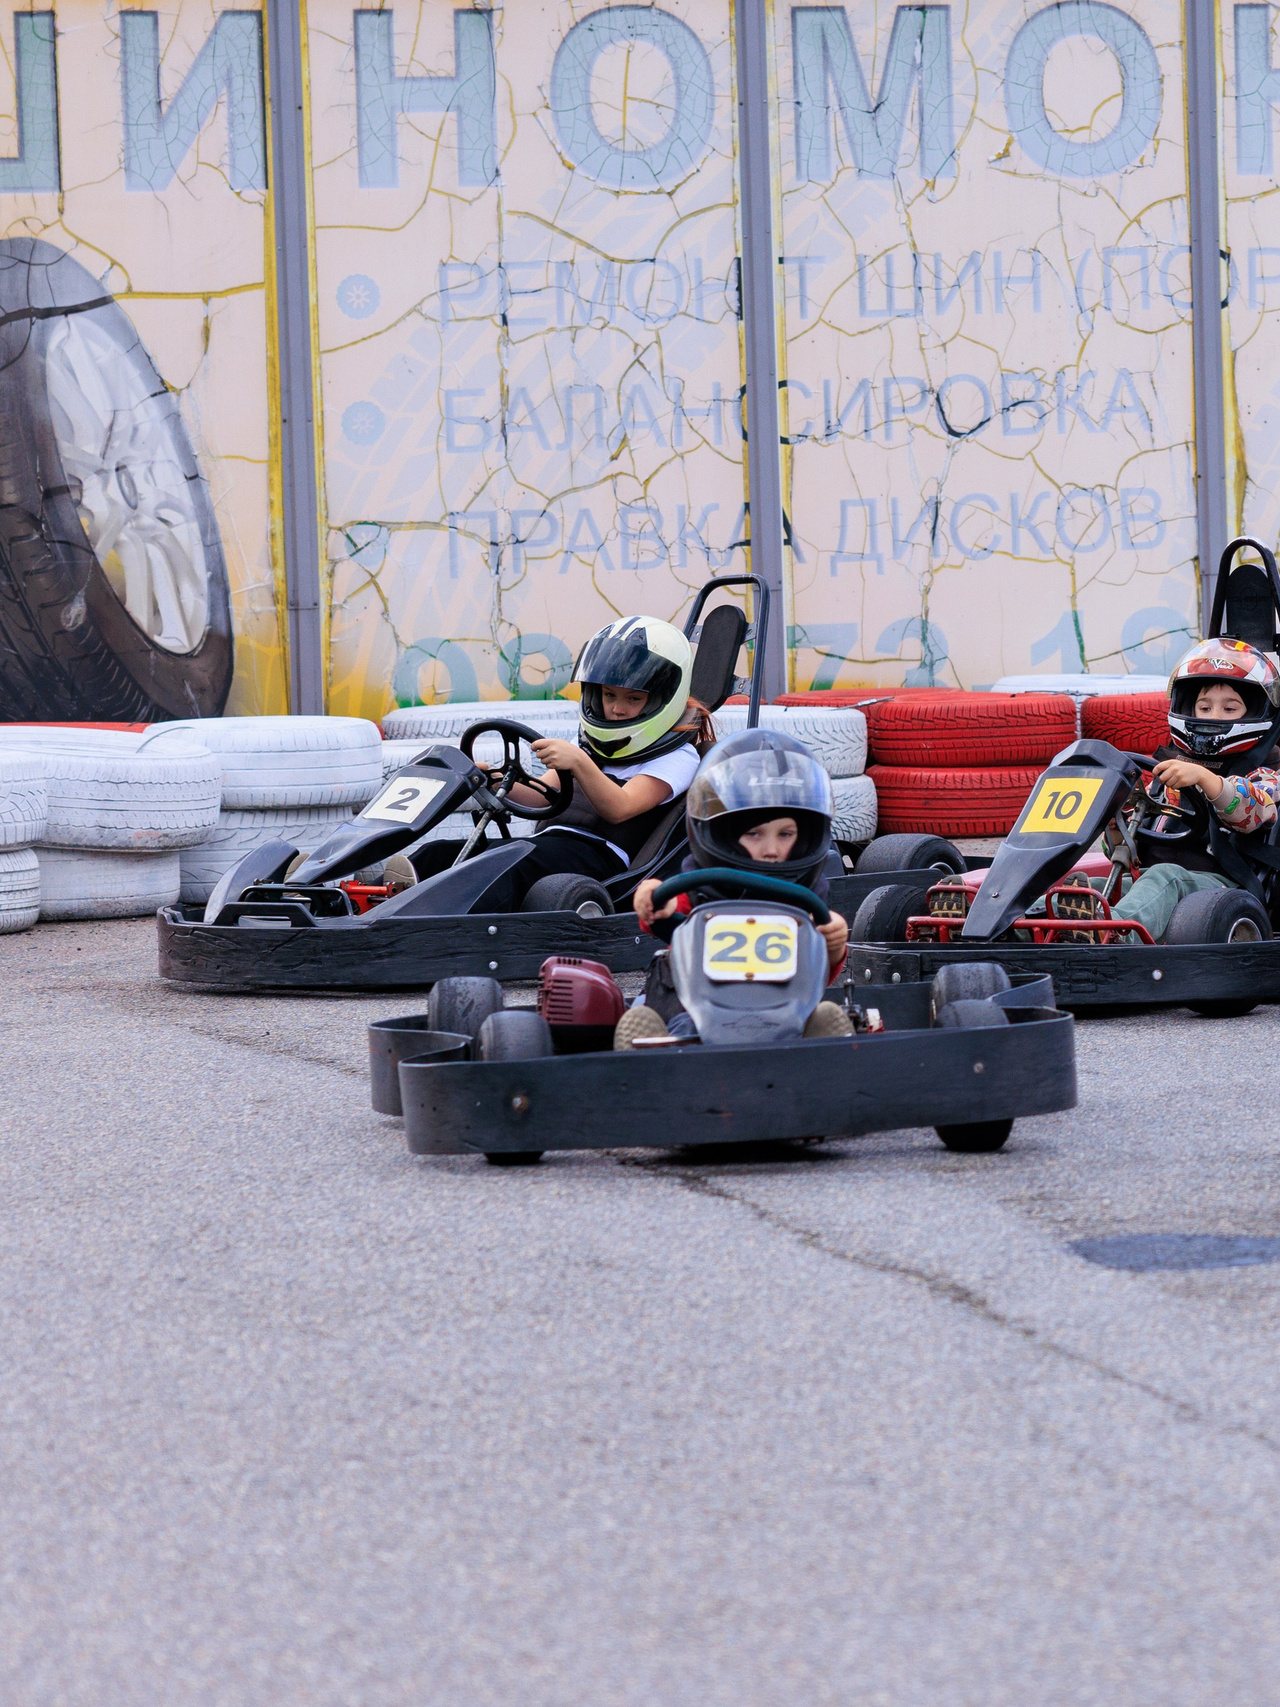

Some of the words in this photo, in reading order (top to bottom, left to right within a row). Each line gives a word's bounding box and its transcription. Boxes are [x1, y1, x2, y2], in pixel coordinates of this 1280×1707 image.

[437, 256, 827, 330] РЕМОНТ
[857, 250, 1042, 320] ШИН
[443, 367, 1154, 454] БАЛАНСИРОВКА
[449, 500, 807, 579] ПРАВКА
[830, 486, 1168, 579] ДИСКОВ
[385, 787, 421, 811] 2
[1042, 790, 1083, 820] 10
[709, 931, 792, 964] 26
